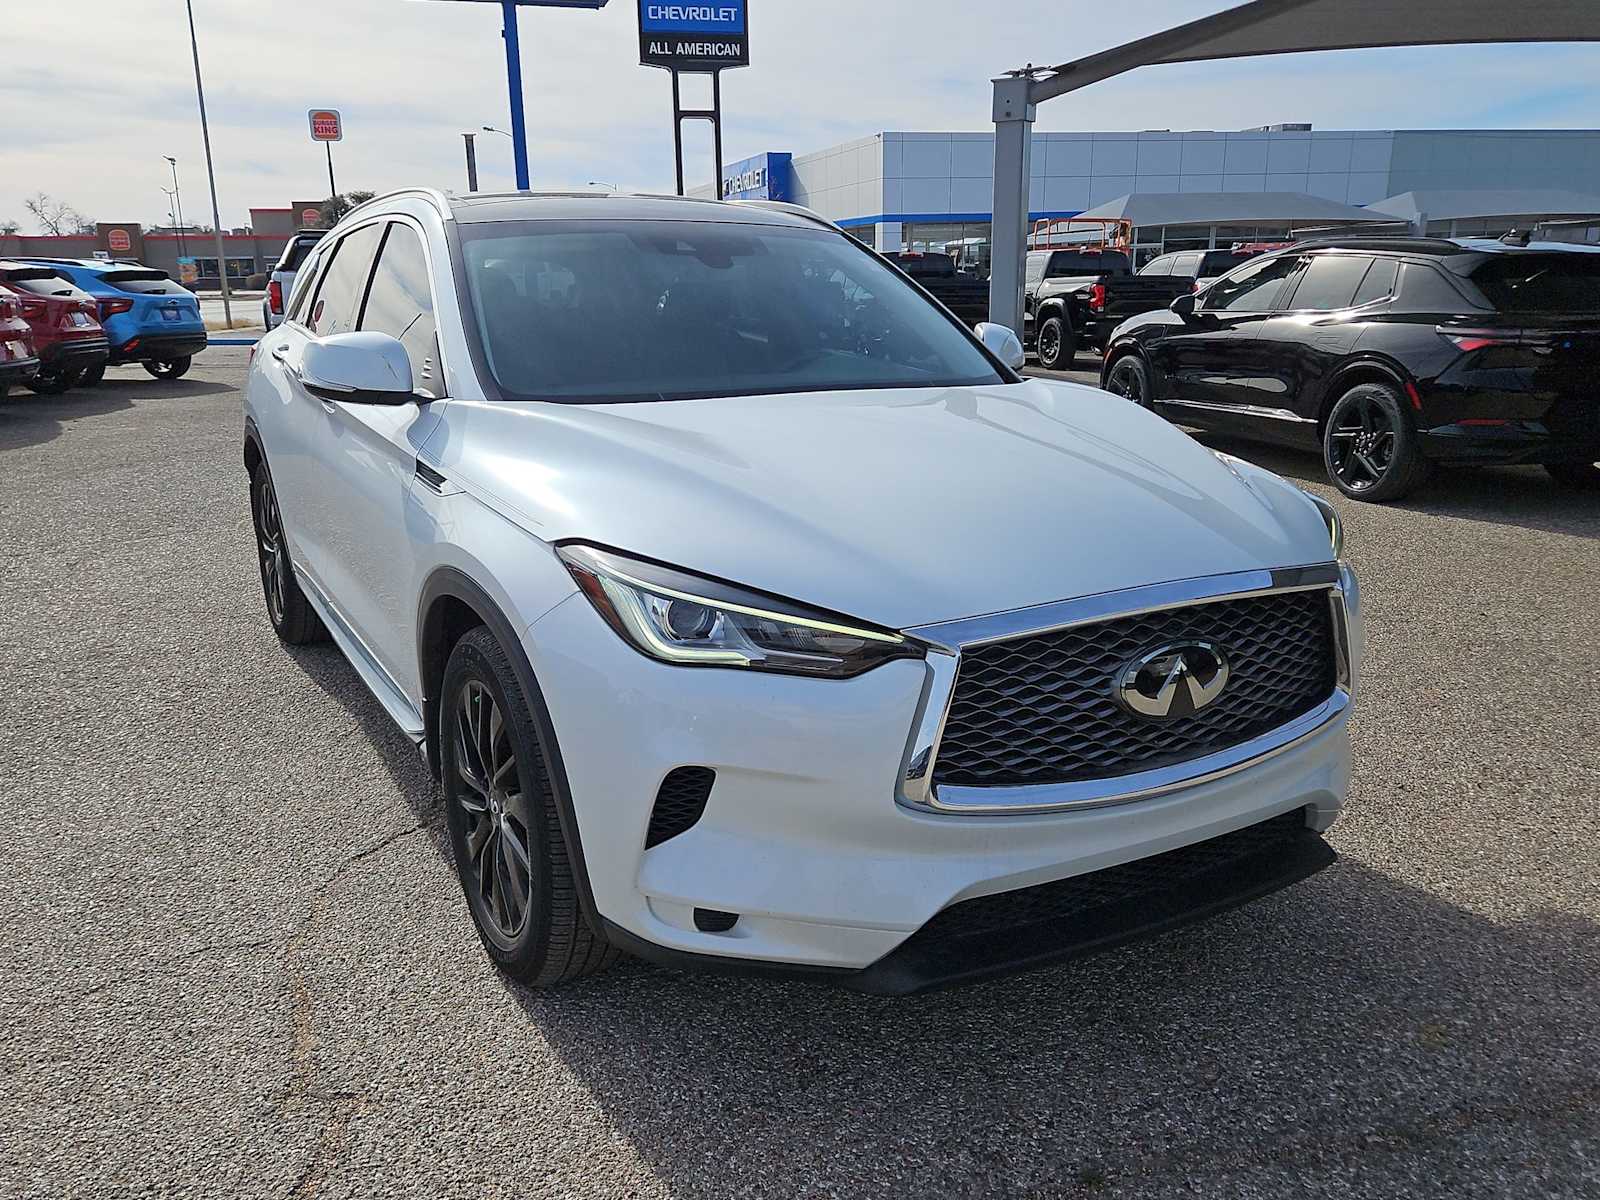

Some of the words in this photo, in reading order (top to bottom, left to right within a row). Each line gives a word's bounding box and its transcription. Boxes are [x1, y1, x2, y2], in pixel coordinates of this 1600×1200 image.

[648, 5, 738, 21] CHEVROLET
[649, 42, 672, 55] ALL
[676, 42, 740, 56] AMERICAN
[313, 126, 338, 134] KING
[728, 168, 767, 194] CHEVROLET
